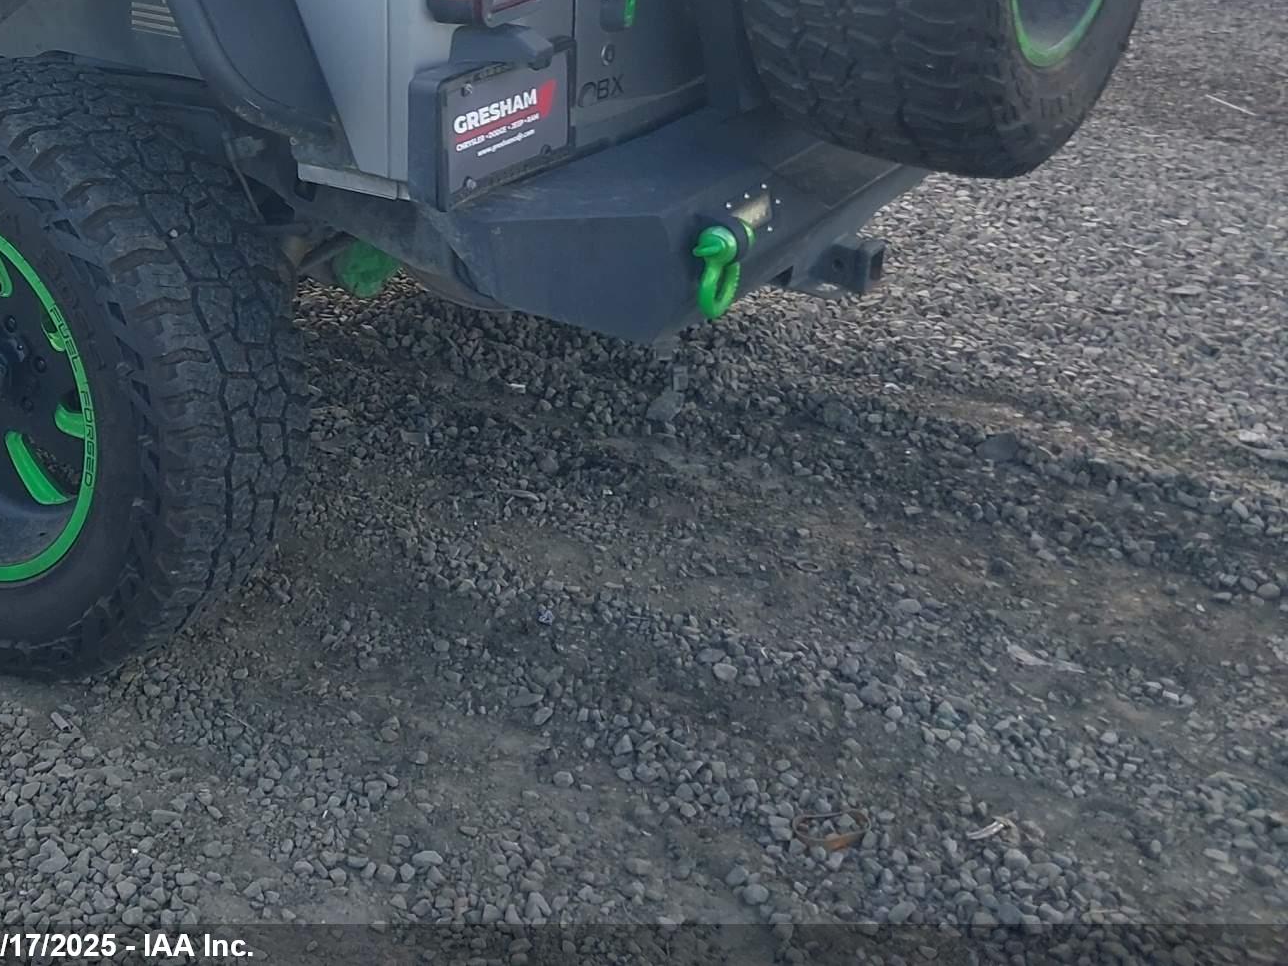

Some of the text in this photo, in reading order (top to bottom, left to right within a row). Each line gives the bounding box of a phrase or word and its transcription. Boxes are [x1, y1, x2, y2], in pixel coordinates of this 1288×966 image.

[454, 88, 538, 134] GRESHAM
[49, 303, 80, 373] FUEL
[80, 389, 96, 488] FORGED
